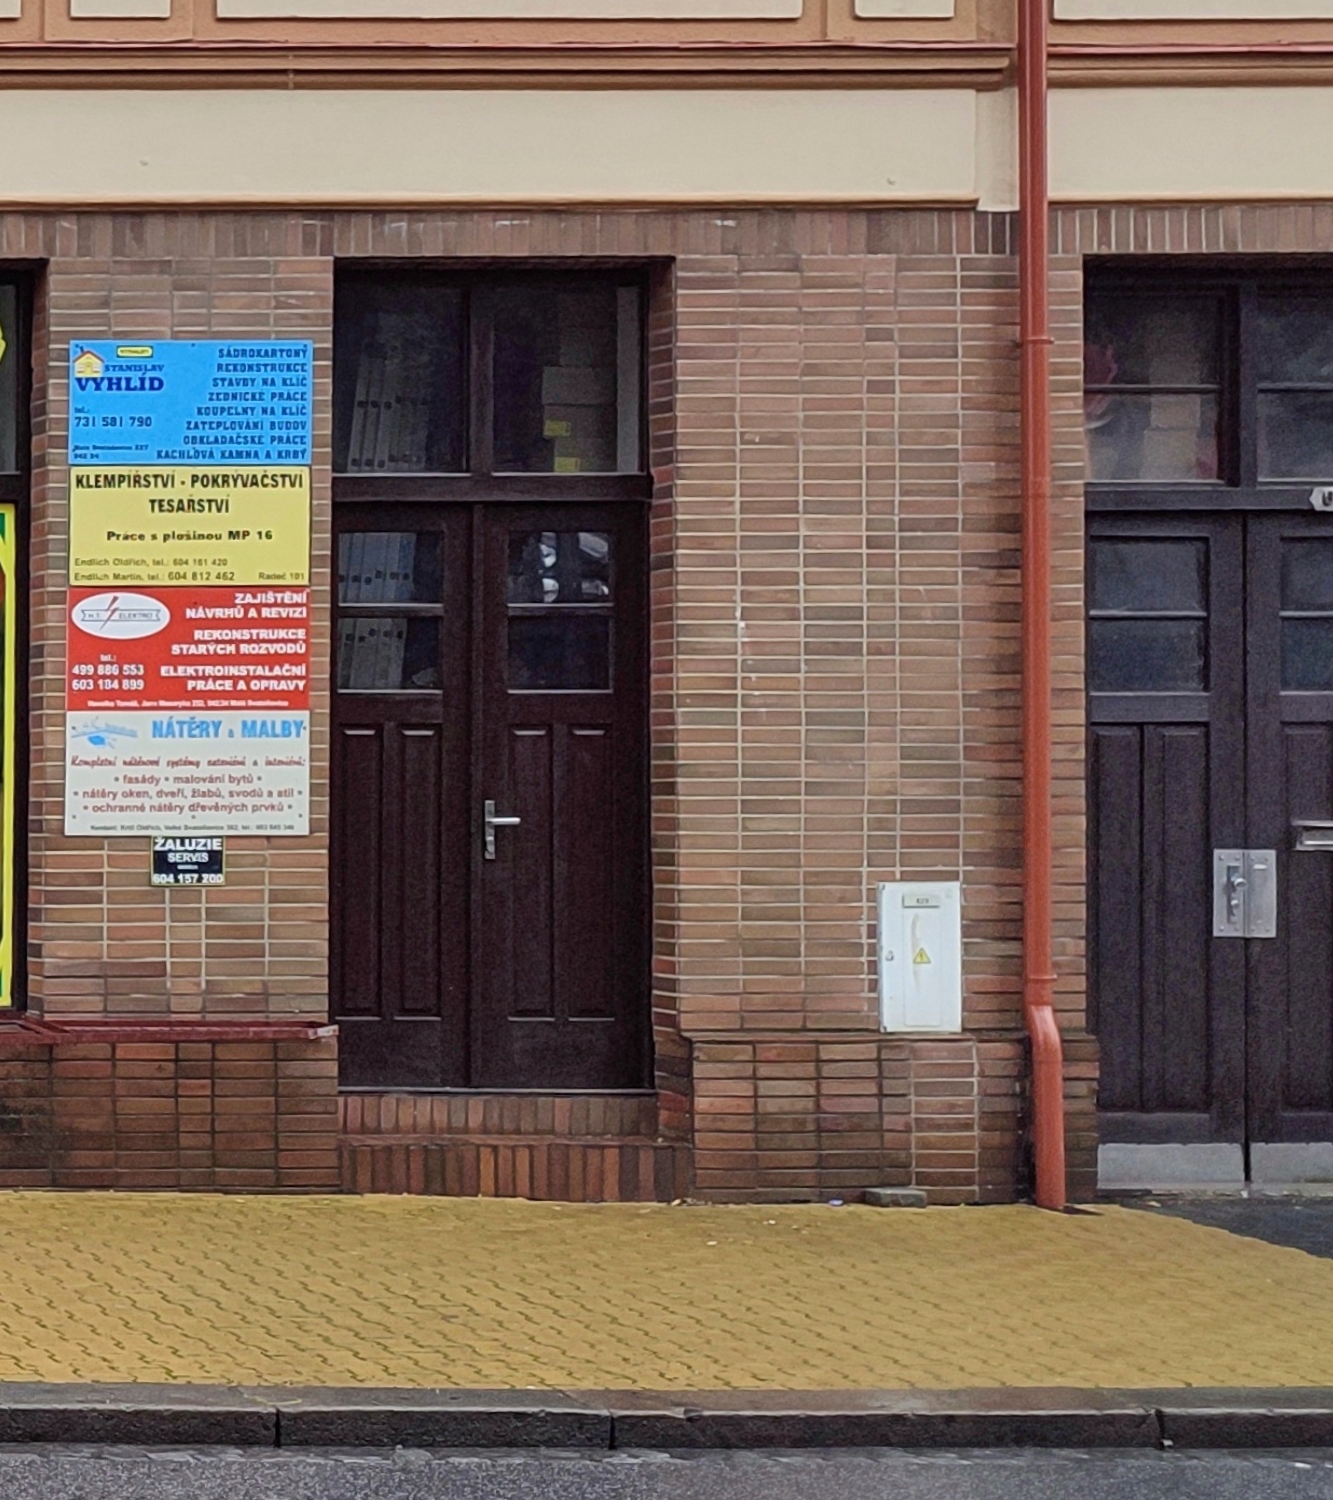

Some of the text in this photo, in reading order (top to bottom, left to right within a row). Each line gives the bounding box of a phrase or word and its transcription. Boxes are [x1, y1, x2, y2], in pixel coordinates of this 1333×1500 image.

[104, 364, 164, 372] STANISLAV
[217, 363, 307, 373] REKONSTRUKCE
[212, 374, 307, 387] STAVBY NA KLÍČ
[208, 389, 307, 401] ZEDNICKÉ PRÁCE
[196, 404, 307, 416] KOUPELNY NA KLÍČ
[74, 416, 96, 428] 731
[129, 416, 152, 428] 790
[186, 418, 307, 431] ZATEPLOVÁNÍ BUDOV
[183, 432, 307, 445] OBKLADAČSKÉ PRÁCE
[220, 449, 260, 460] KAMNA
[265, 449, 272, 460] A
[75, 470, 176, 489] KLEMPÍŘSTVÍ
[190, 470, 303, 488] POKRÝVAČSTVÍ
[149, 494, 230, 513] TESAŘSTVÍ
[107, 530, 273, 543] Práce s plošinou MP 16
[235, 590, 307, 604] ZAJIŠTĚNÍ
[186, 605, 244, 619] NÁVRHŮ
[248, 608, 258, 618] A
[194, 629, 306, 640] REKONSTRUKCE
[171, 640, 306, 655] STARÝCH ROZVODŮ
[160, 663, 306, 676] ELEKTROINSTALAČNÍ
[187, 678, 306, 691] PRÁCE A OPRAVY
[152, 716, 222, 738] NÁTĚRY
[241, 719, 304, 738] MALBY
[122, 773, 254, 786] fasády malování bytů
[82, 788, 118, 801] nátěry
[121, 788, 153, 799] oken,
[228, 787, 264, 798] svodů
[267, 790, 274, 798] a
[92, 802, 284, 815] ochranné nátěry dřevěných prvků
[154, 836, 223, 851] ŽALUZIE
[167, 852, 209, 863] SERVIS
